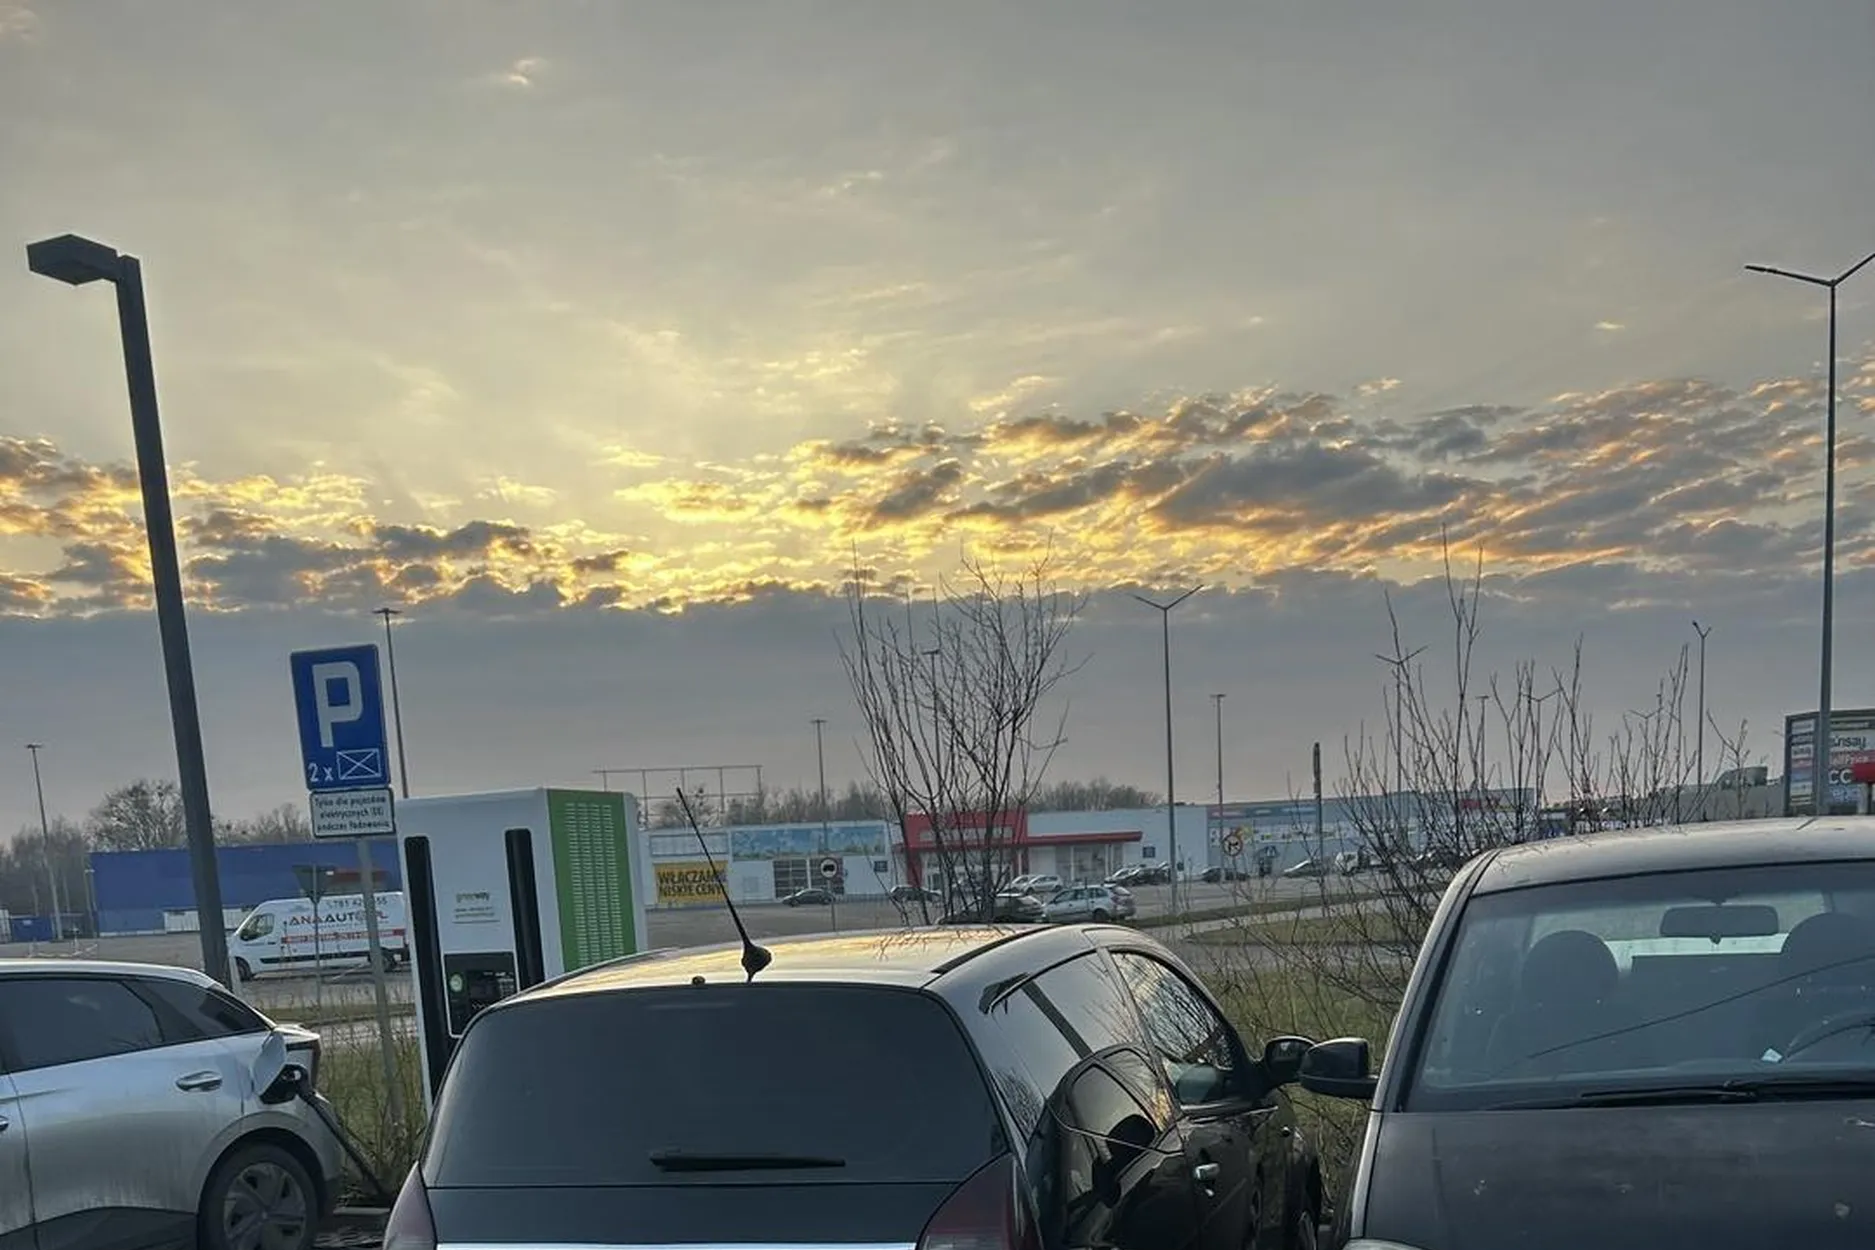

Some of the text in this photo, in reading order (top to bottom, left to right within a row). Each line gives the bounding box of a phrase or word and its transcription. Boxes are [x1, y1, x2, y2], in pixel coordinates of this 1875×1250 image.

[311, 661, 364, 749] P
[308, 763, 335, 783] 2 x
